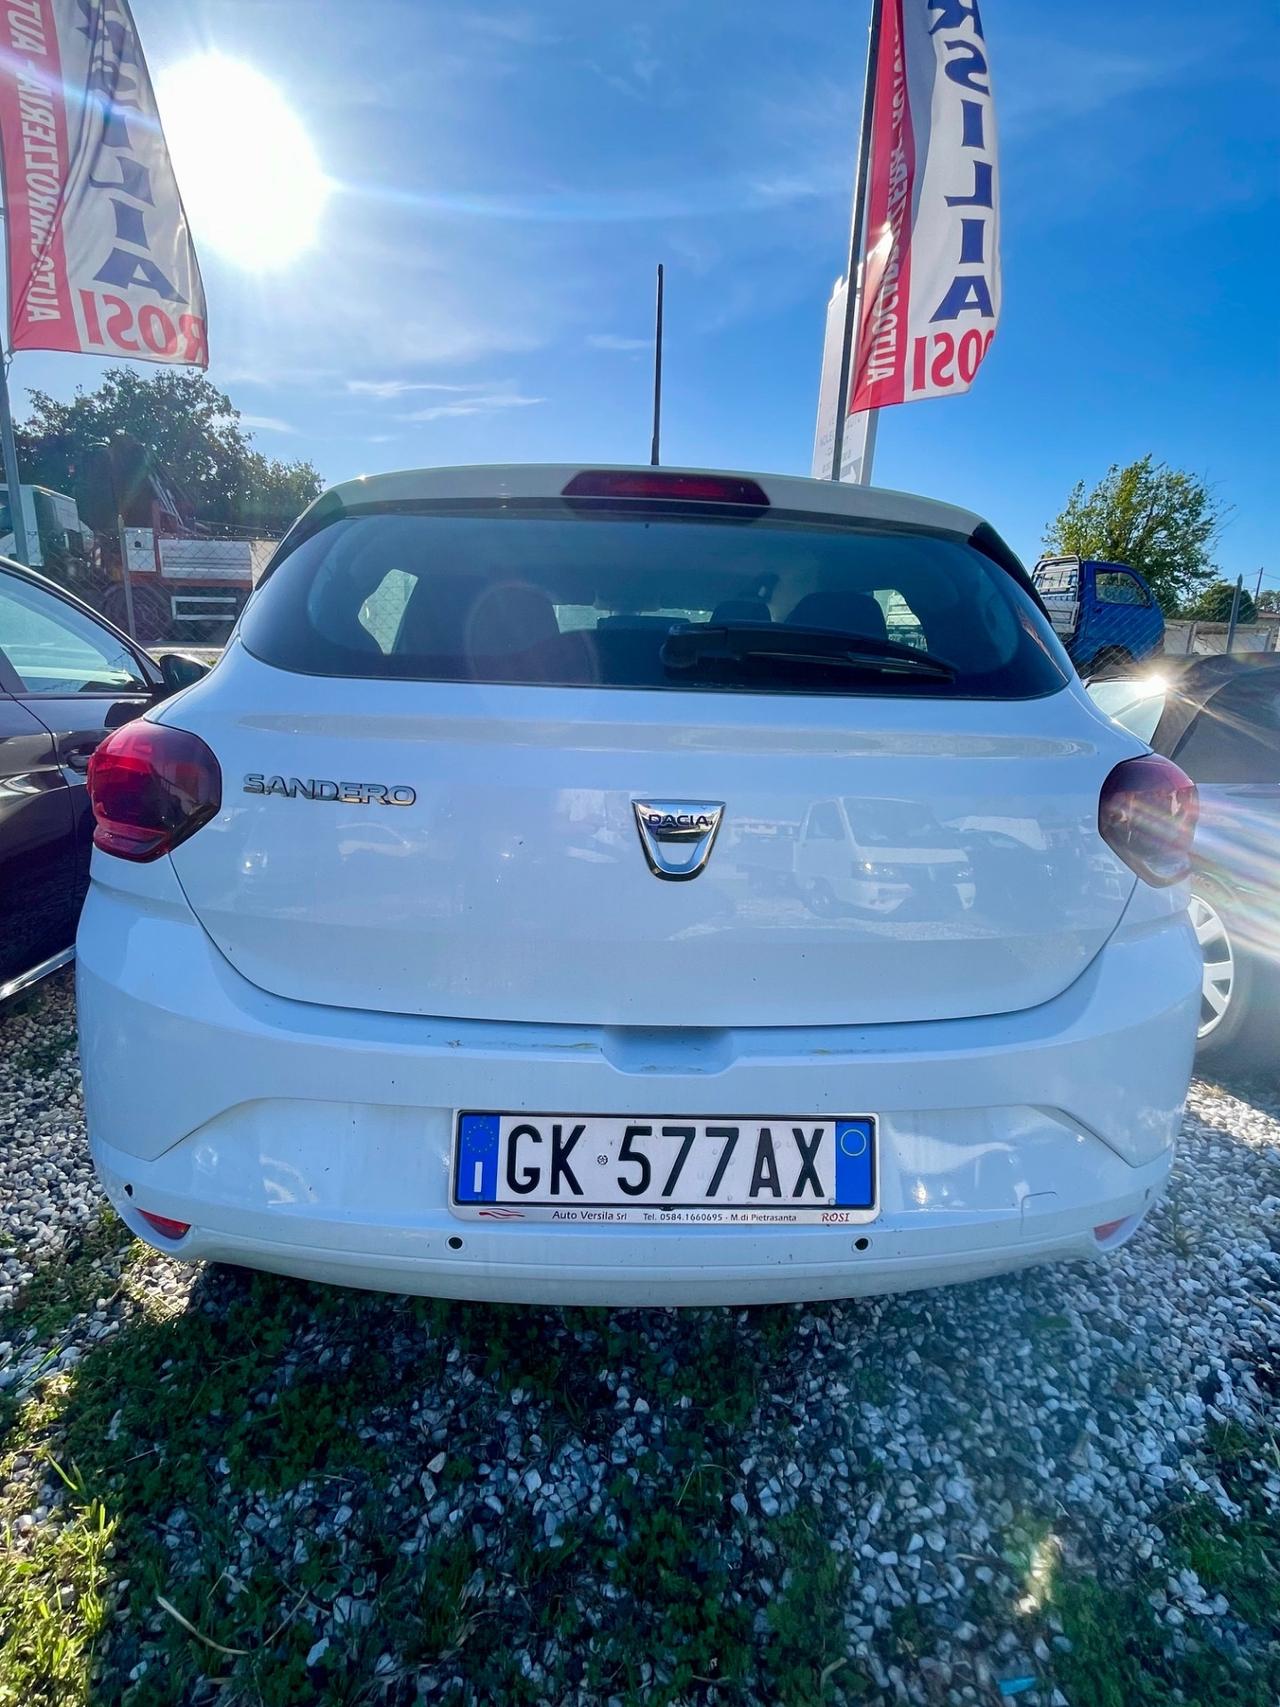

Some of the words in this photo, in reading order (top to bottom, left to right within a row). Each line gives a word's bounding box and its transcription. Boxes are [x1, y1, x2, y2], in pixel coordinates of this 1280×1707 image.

[243, 773, 417, 806] SANDERO
[648, 813, 709, 827] DACIA
[506, 1124, 586, 1195] GK
[552, 1211, 578, 1221] Auto
[581, 1211, 614, 1221] Versila
[616, 1212, 627, 1221] Srl
[643, 1212, 657, 1221] Tel.
[751, 1213, 797, 1222] Pietrasanta
[821, 1212, 850, 1222] ROSI
